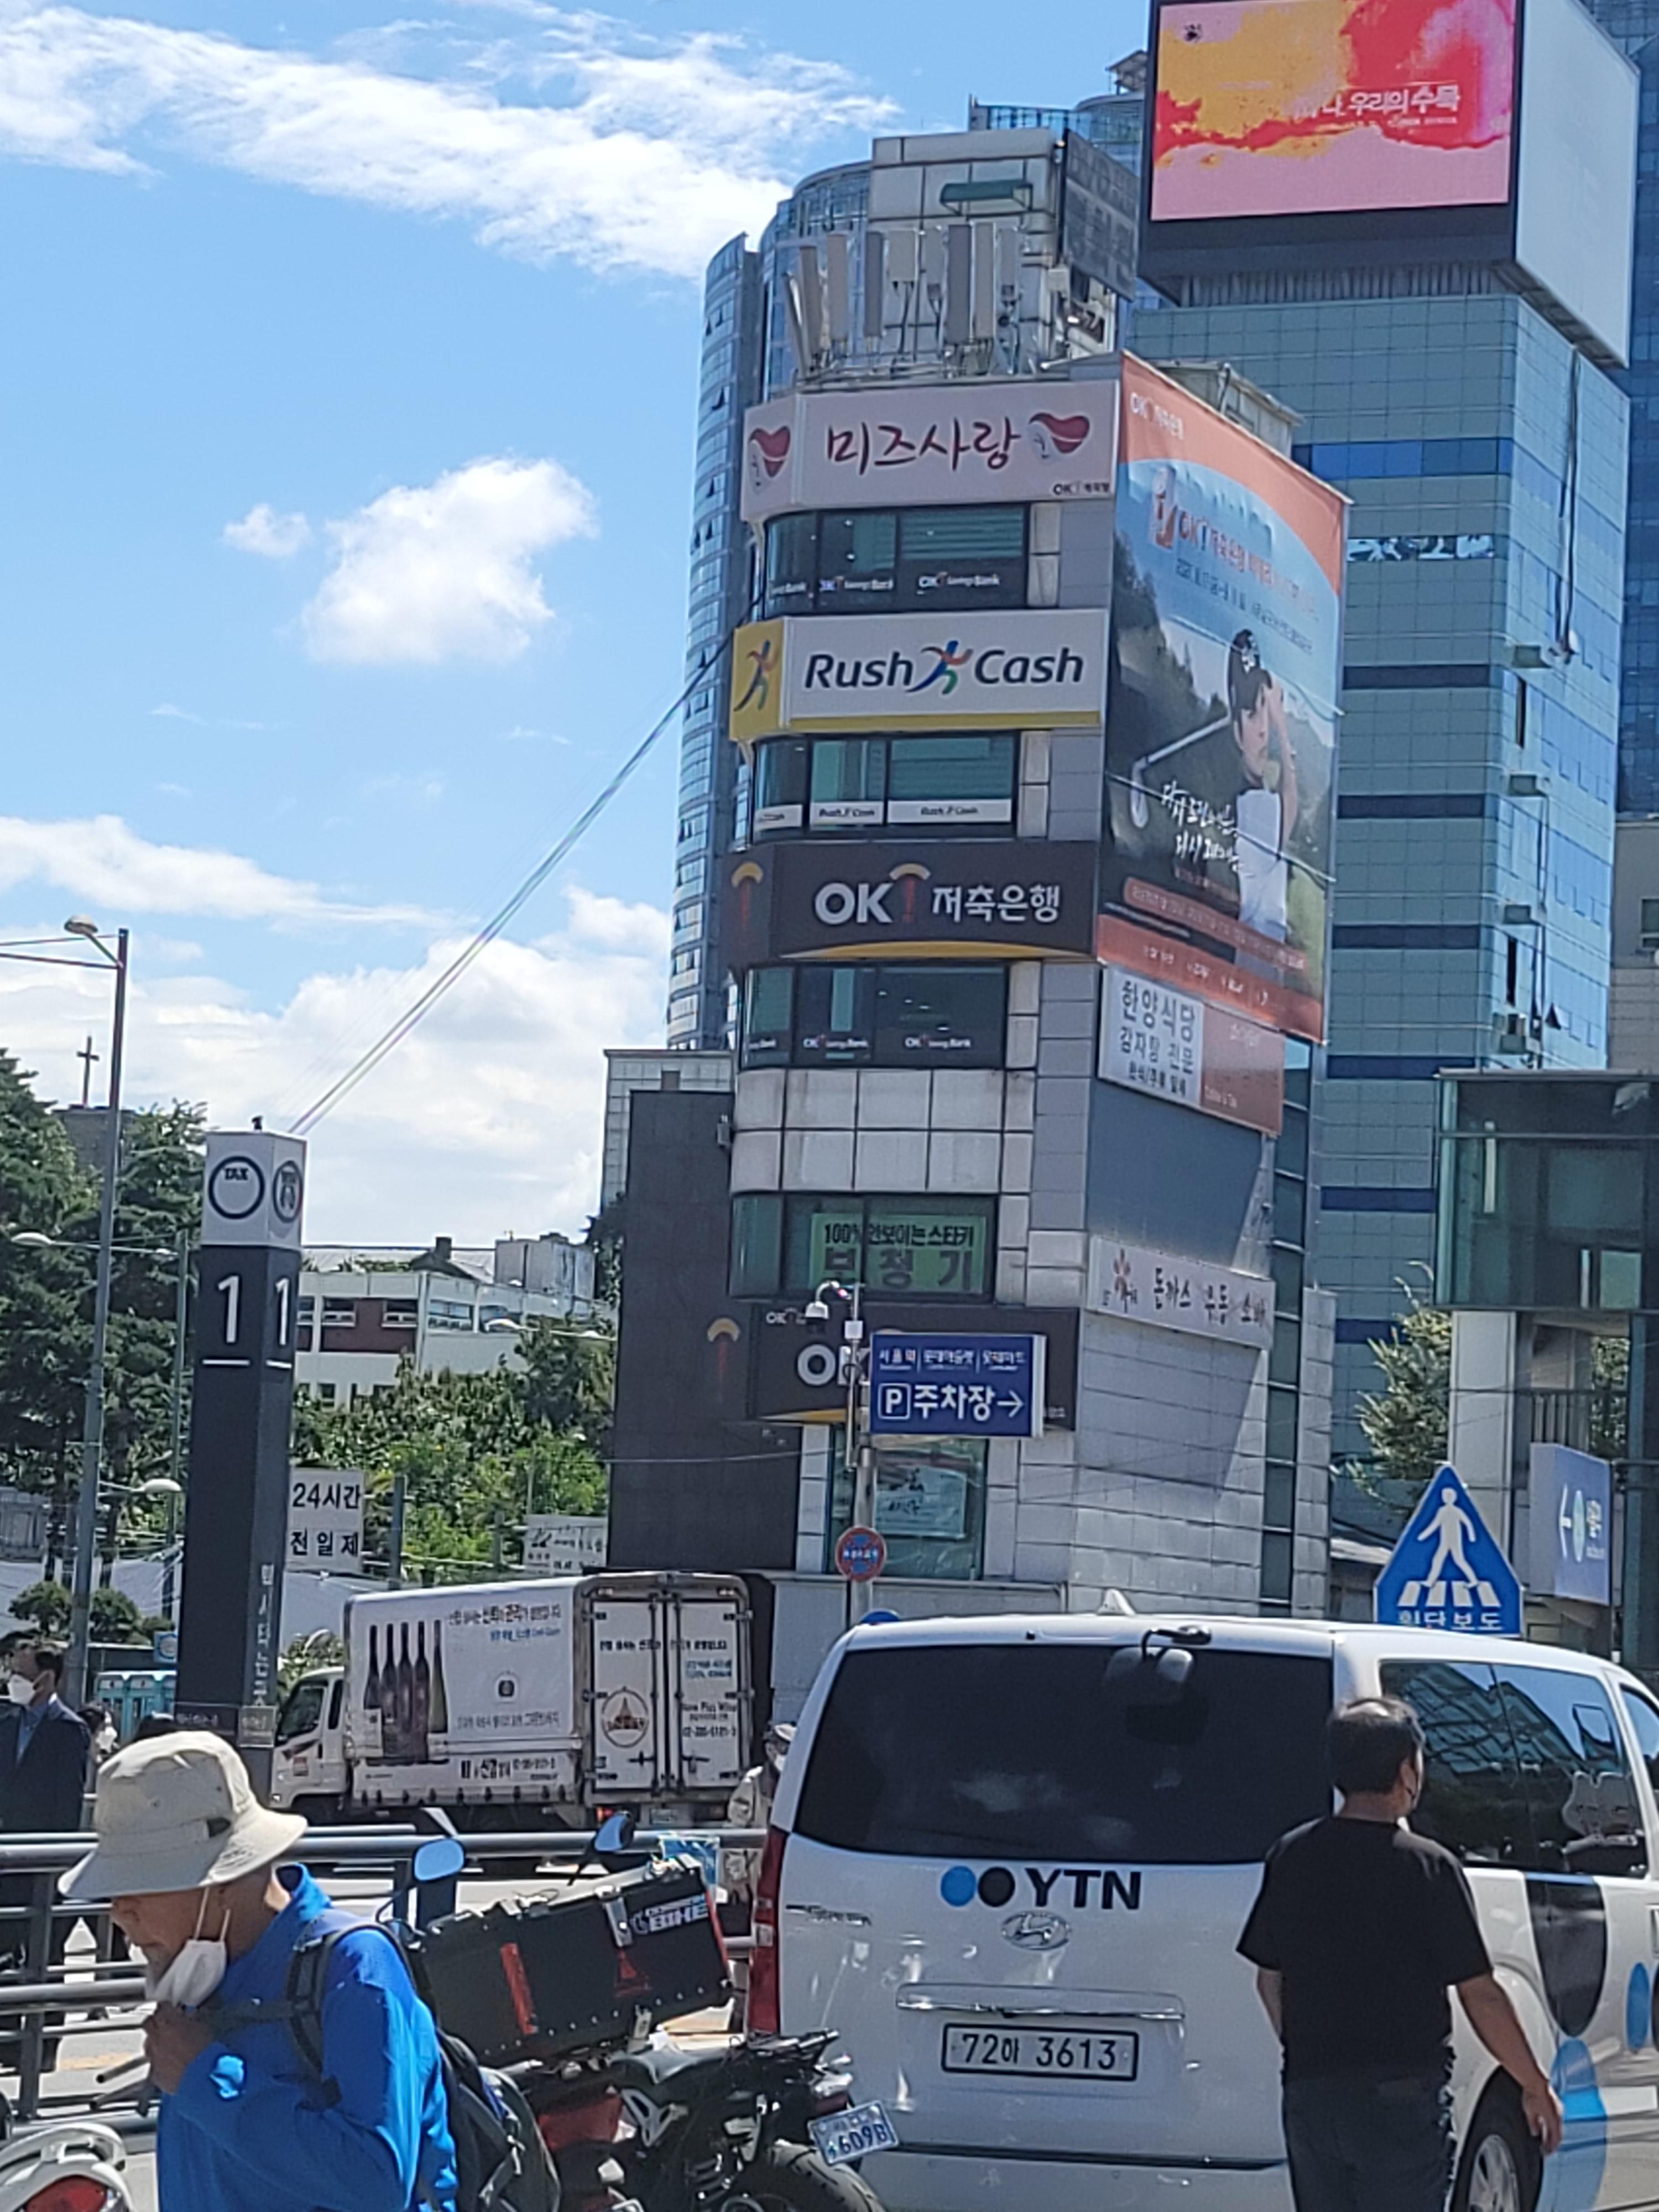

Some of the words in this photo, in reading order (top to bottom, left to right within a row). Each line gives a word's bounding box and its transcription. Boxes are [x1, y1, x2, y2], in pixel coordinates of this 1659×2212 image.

[827, 415, 1022, 476] 미즈사랑
[805, 650, 912, 689] Rush
[974, 647, 1084, 684] Cash
[814, 881, 893, 925] OK
[932, 884, 1061, 923] 저축은행
[1121, 980, 1195, 1044] 한양식당
[825, 1246, 973, 1291] 보청기
[218, 1275, 239, 1344] 1
[276, 1277, 290, 1346] 1
[885, 1388, 903, 1414] P
[913, 1384, 996, 1422] 주차장
[291, 1483, 361, 1510] 24시간
[290, 1530, 359, 1557] 전일제
[1025, 1867, 1142, 1910] YTN
[1036, 2037, 1116, 2070] 3613
